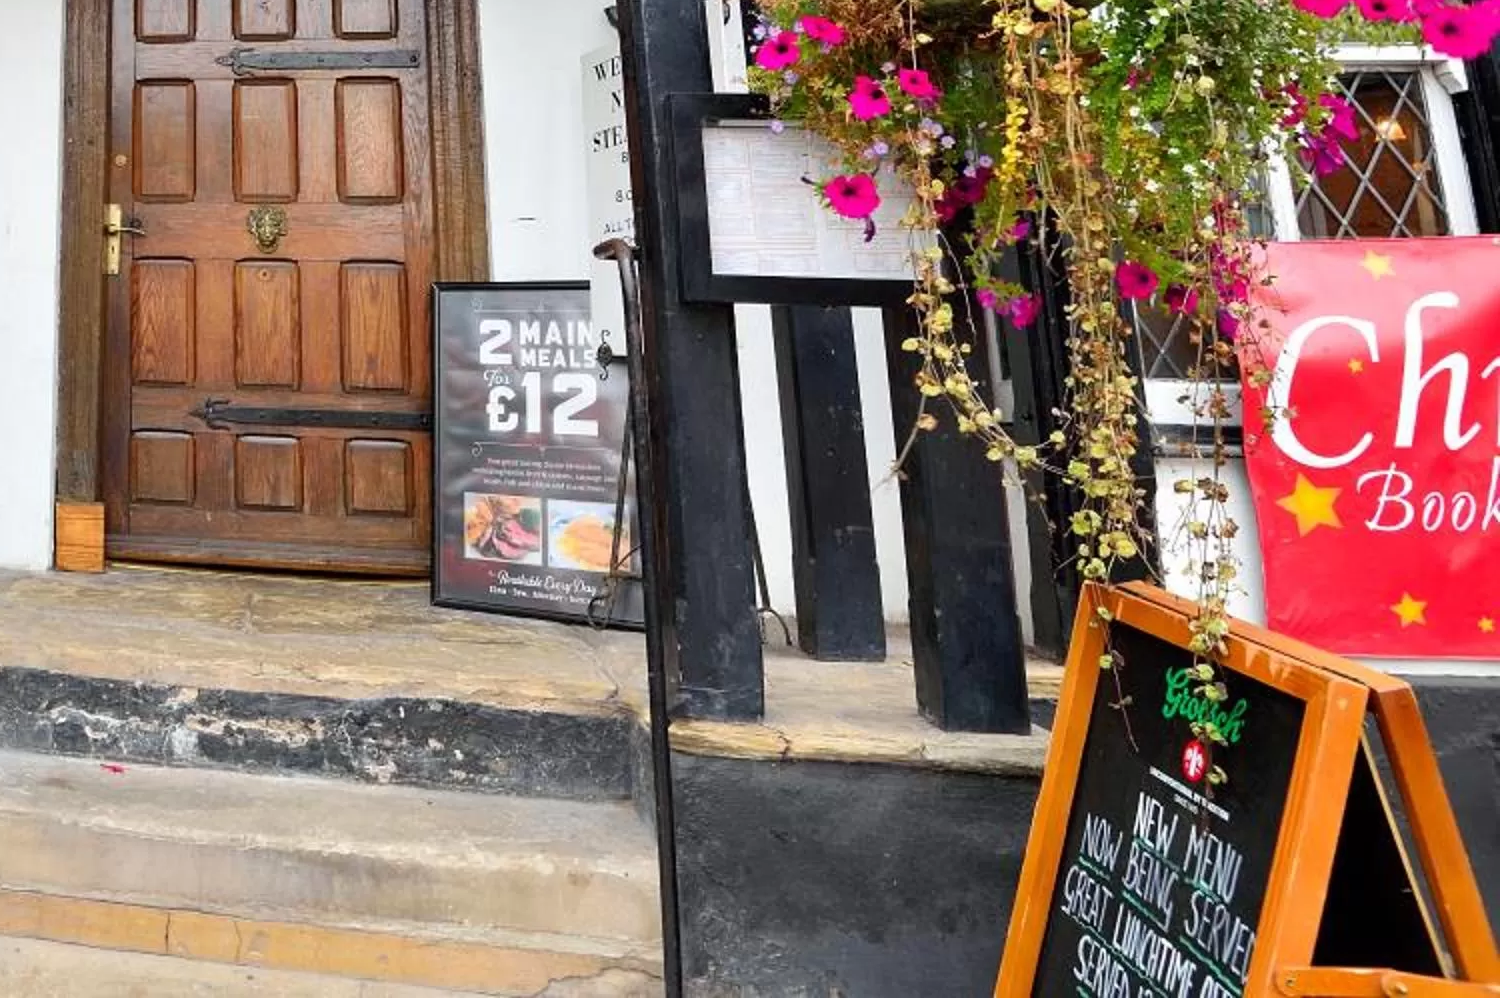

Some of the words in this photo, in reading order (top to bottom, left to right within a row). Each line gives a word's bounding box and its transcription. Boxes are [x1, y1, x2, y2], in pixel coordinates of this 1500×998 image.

[479, 318, 513, 366] 2
[519, 318, 594, 347] MAIN
[521, 348, 599, 369] MEALS
[486, 370, 599, 437] £12
[1079, 811, 1123, 872] NOW
[1121, 840, 1179, 933] BEING
[1133, 791, 1179, 857] NEW
[1183, 824, 1243, 904] MENU
[1061, 865, 1115, 933] GREAT
[1112, 903, 1197, 998] LUNCHTIME
